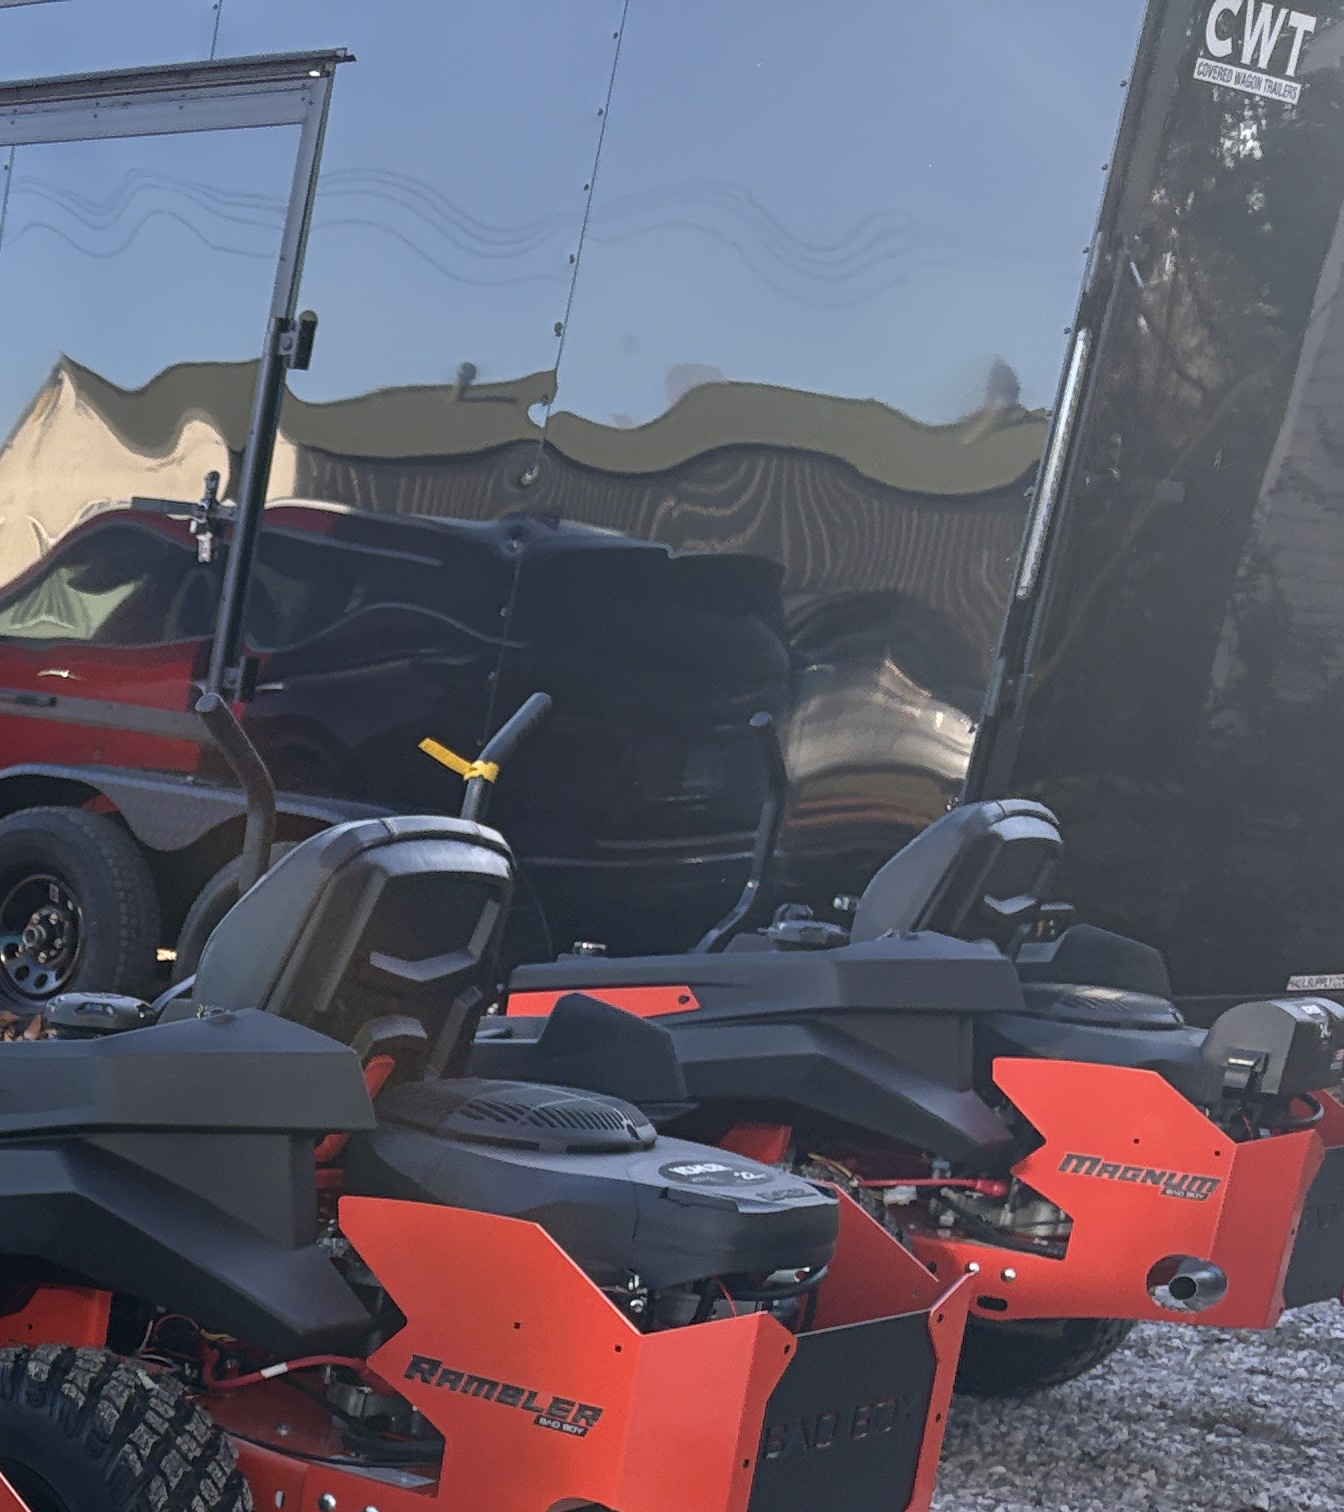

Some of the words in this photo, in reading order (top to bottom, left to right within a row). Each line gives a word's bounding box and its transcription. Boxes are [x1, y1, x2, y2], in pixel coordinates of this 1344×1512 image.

[1206, 0, 1317, 77] CWT
[1058, 1153, 1221, 1194] MAGNUM
[404, 1354, 604, 1428] RAMBLER
[538, 1416, 562, 1430] BAD
[562, 1423, 585, 1435] BOY
